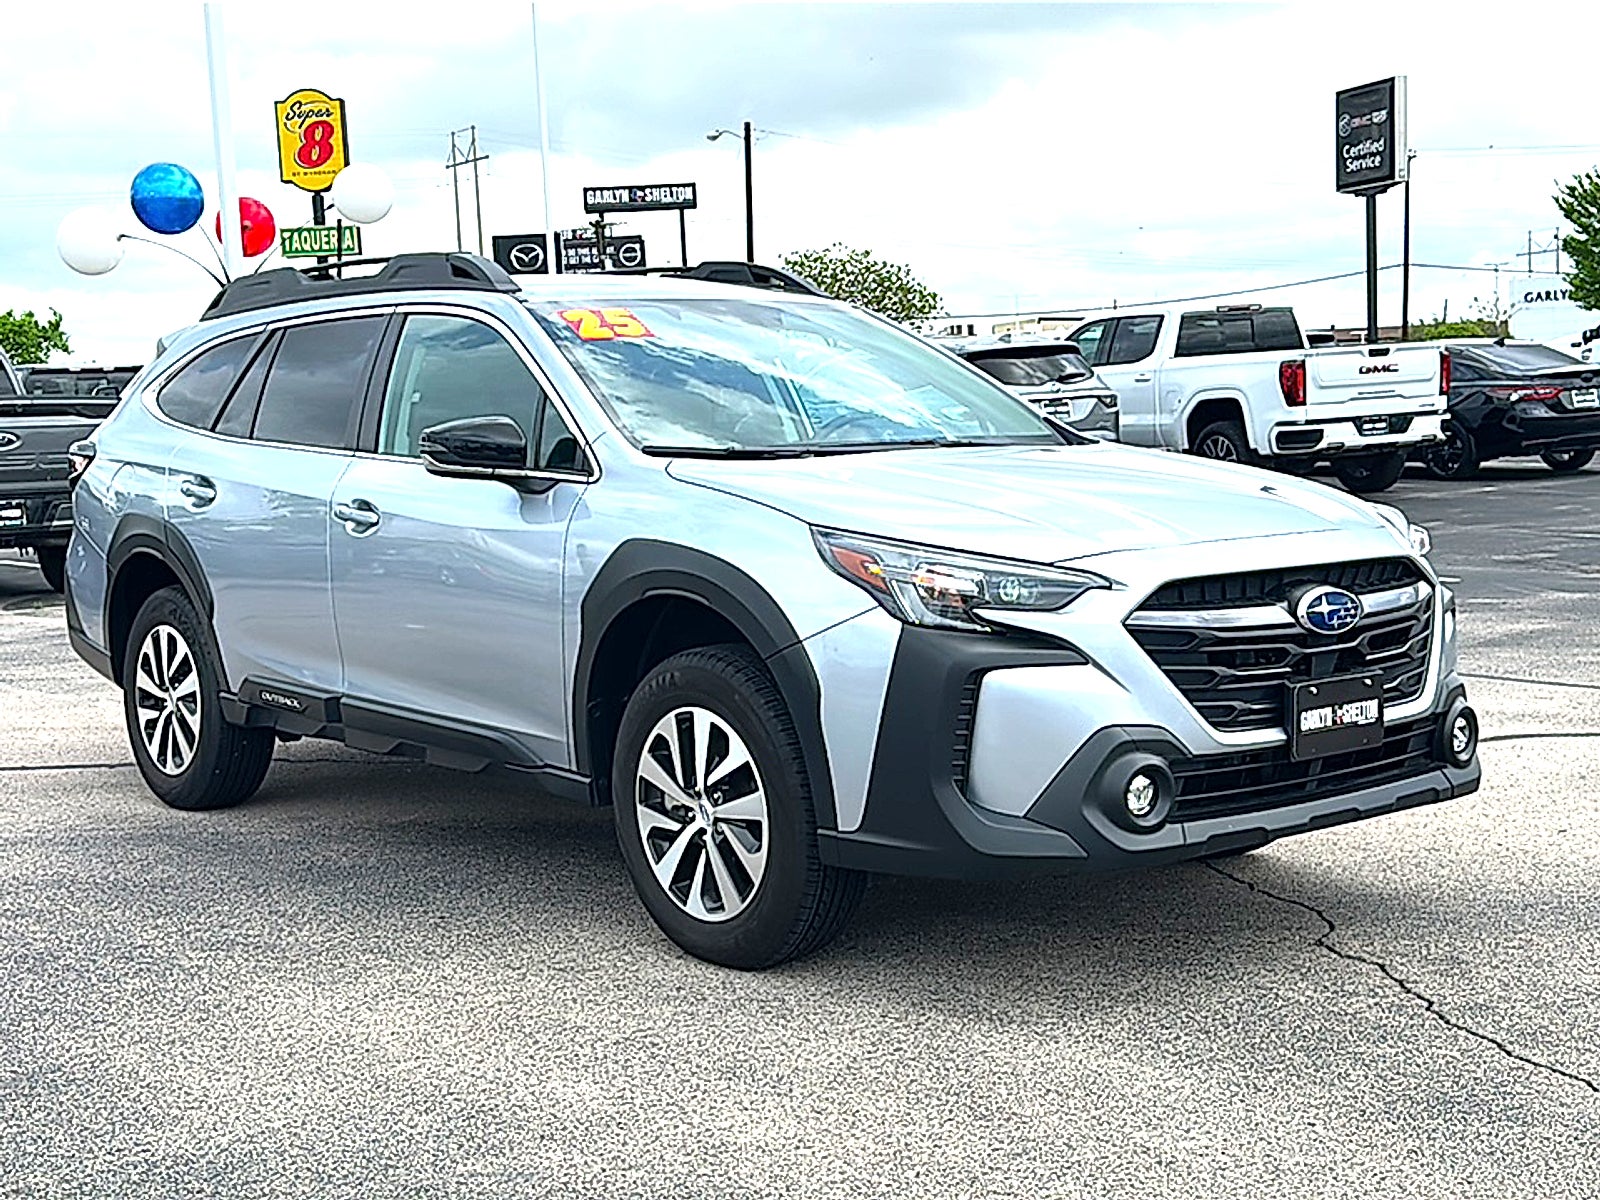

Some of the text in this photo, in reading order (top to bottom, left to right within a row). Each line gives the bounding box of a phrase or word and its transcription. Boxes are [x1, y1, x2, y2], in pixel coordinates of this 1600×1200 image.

[285, 100, 334, 129] Super
[296, 119, 335, 169] 8
[1342, 137, 1385, 158] Certified
[1345, 154, 1381, 173] Service
[586, 186, 694, 204] GARLYN SHELTON
[282, 229, 354, 251] TAQUERA
[1523, 289, 1570, 303] GARLY
[560, 307, 647, 338] 25
[1358, 363, 1399, 374] GMC
[261, 691, 300, 708] OUTBACK
[1342, 698, 1379, 723] SHELTON
